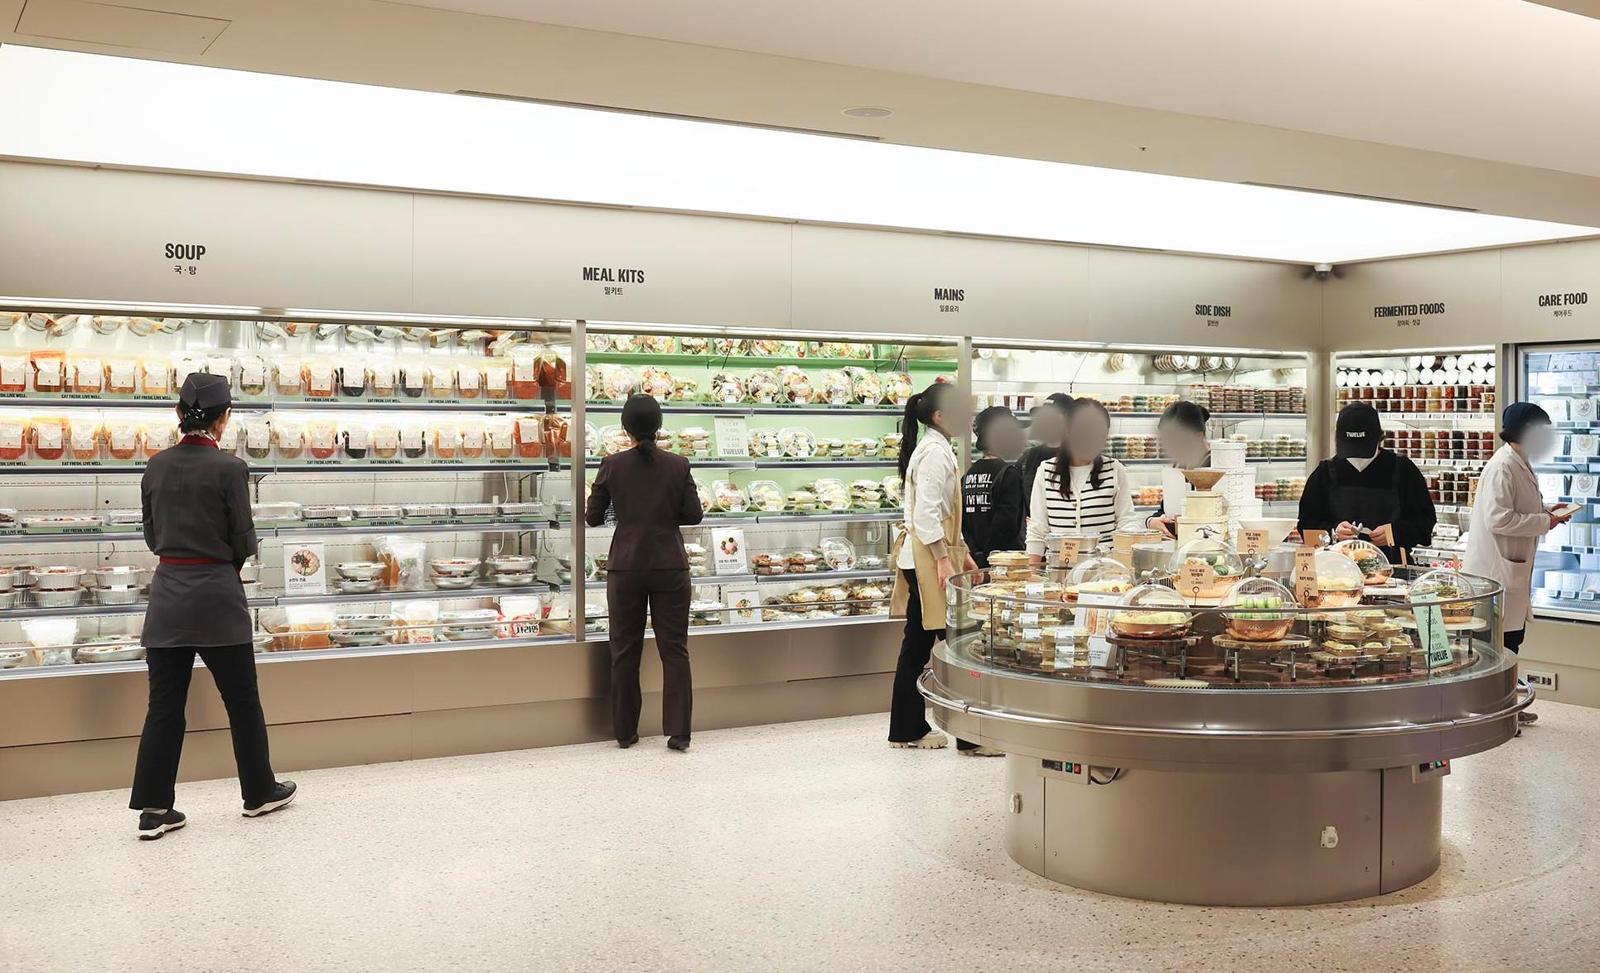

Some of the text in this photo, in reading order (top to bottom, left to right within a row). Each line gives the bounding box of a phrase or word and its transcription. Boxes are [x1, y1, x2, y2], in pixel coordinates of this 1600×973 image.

[165, 243, 206, 260] SOUP
[583, 267, 644, 284] MEAL KITS
[604, 286, 623, 296] 밀키트
[934, 288, 964, 301] MAINS
[1538, 292, 1588, 306] CARE FOOD
[1195, 304, 1230, 317] SIDE DISH
[1374, 302, 1445, 318] FERMENTED FOODS
